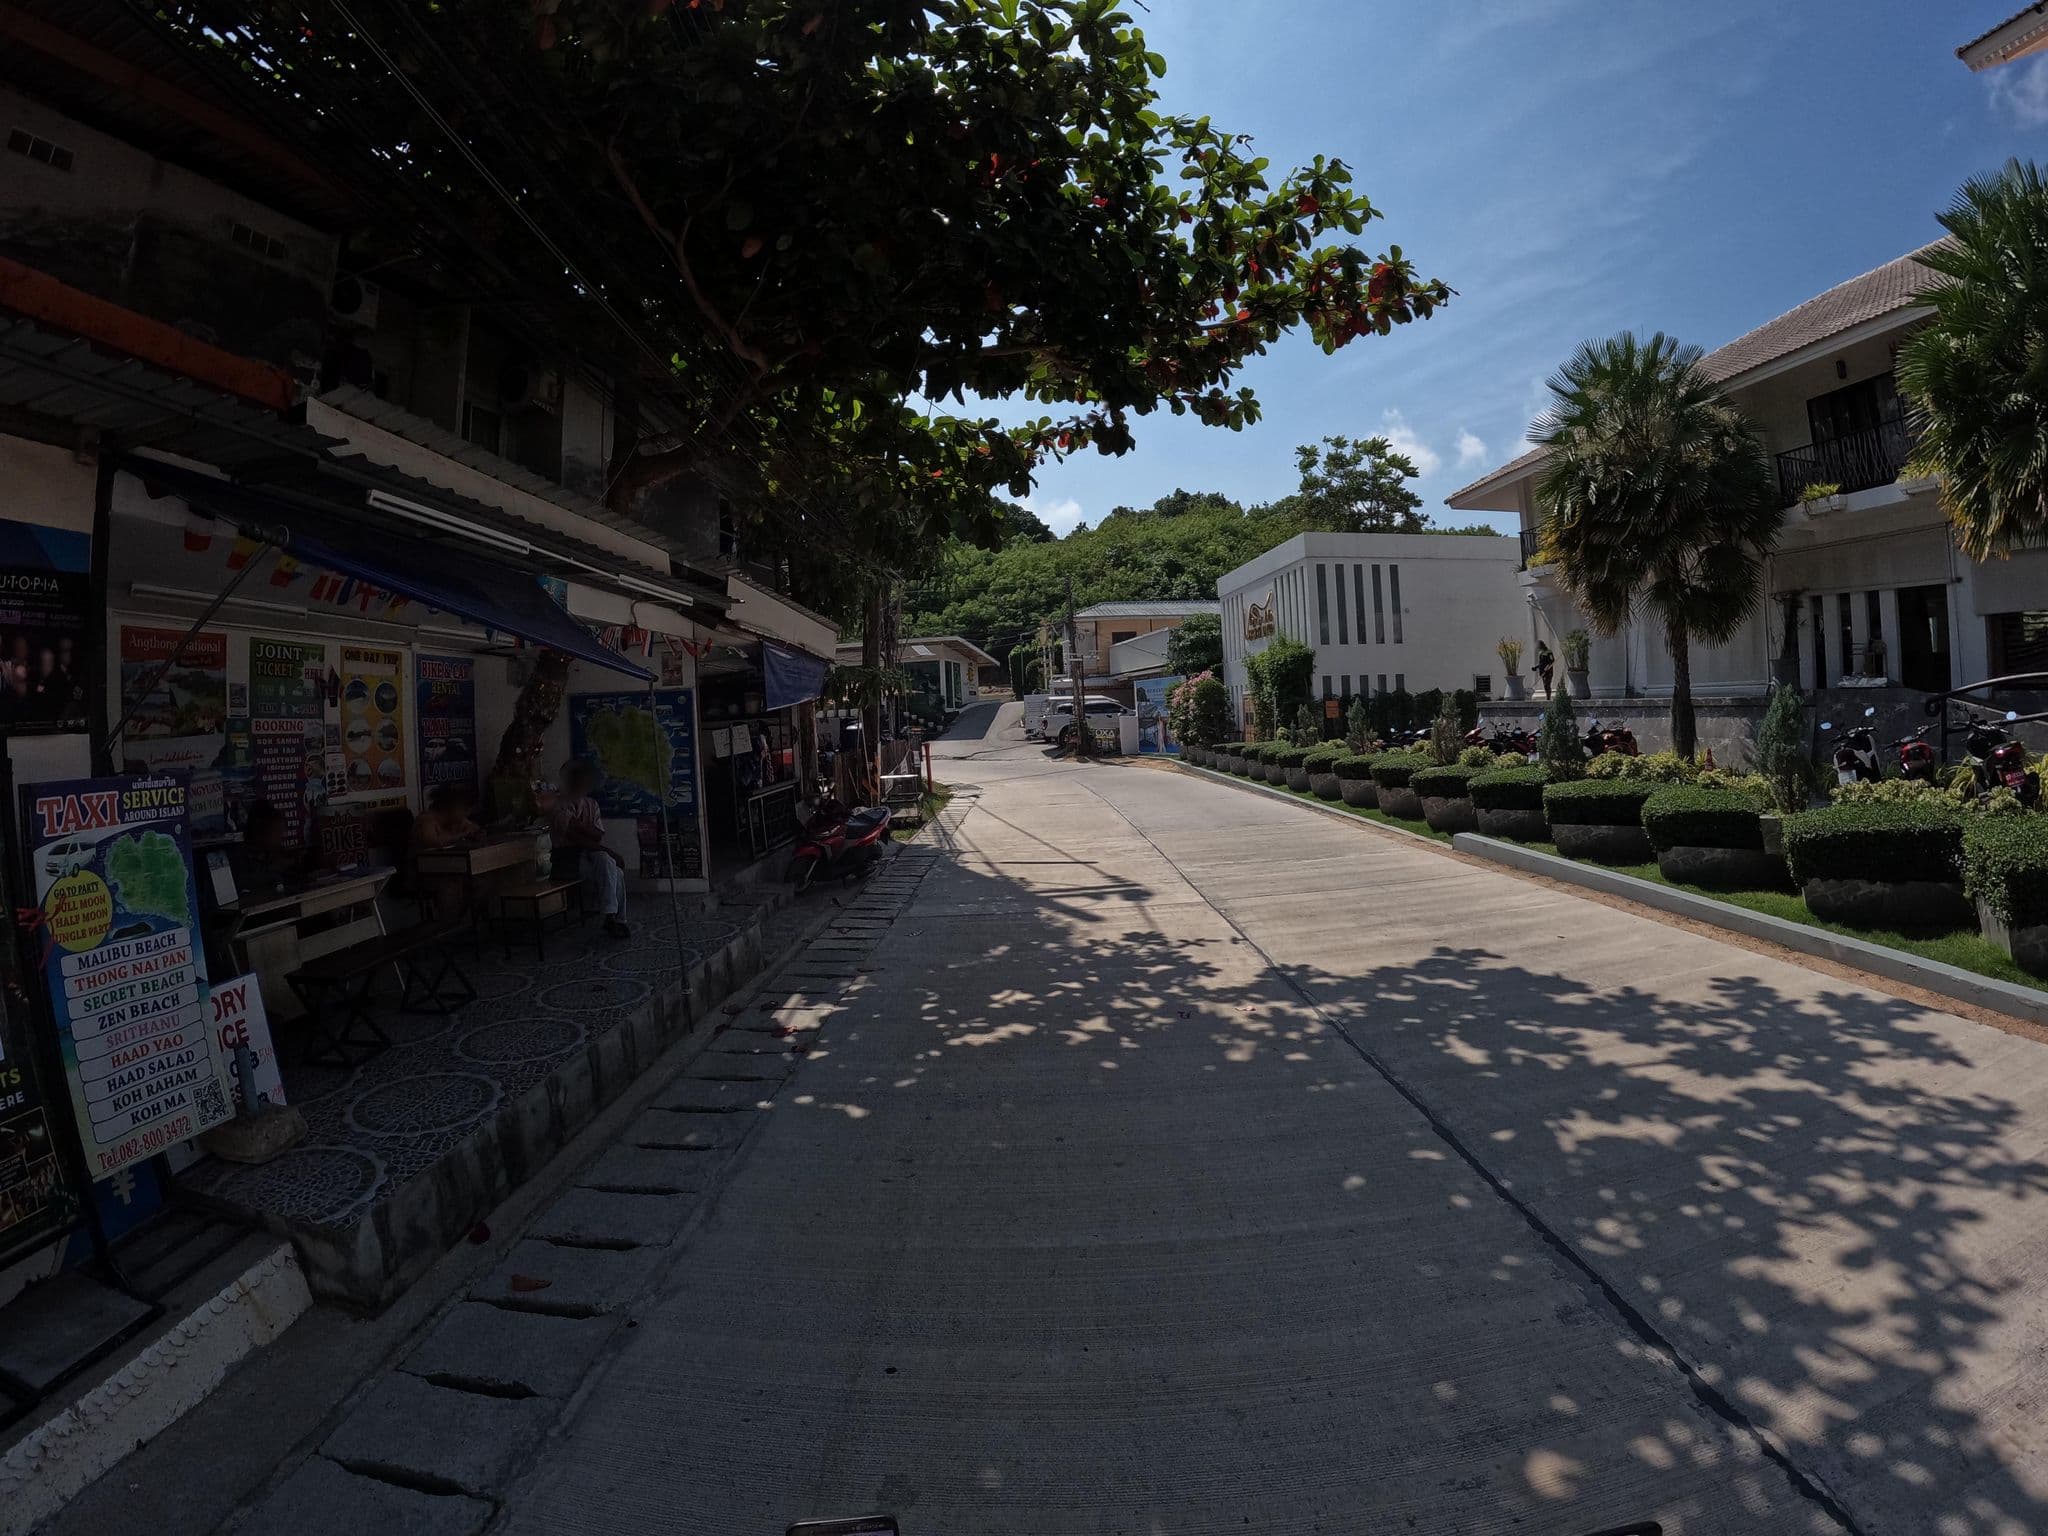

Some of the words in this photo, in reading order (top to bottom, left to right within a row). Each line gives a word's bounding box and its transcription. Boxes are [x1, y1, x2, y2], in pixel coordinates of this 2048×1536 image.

[180, 638, 222, 654] ational
[256, 644, 303, 661] JOINT
[256, 661, 294, 678] TICKET
[255, 720, 304, 732] BOOKING
[36, 790, 120, 838] TAXI
[122, 787, 185, 810] SERVICE
[124, 808, 157, 822] AROUND
[158, 805, 185, 819] ISLAND
[53, 887, 65, 898] GO
[66, 886, 77, 896] TO
[78, 881, 99, 895] PARTY
[79, 894, 106, 909] MOON
[55, 913, 81, 928] HALF
[82, 907, 108, 922] MOON
[78, 945, 131, 971] MALIBU
[135, 932, 177, 955] BEACH
[75, 965, 128, 992] THONG
[132, 956, 160, 977] NAI
[163, 950, 187, 969] PAN
[84, 984, 138, 1012] SECRET
[141, 970, 185, 995] BEACH
[98, 1009, 127, 1031] ZEN
[131, 993, 181, 1018] BEACH
[106, 1014, 181, 1048] SRITHANU
[111, 1043, 152, 1068] HAAD
[153, 1034, 184, 1053] YAO
[107, 1068, 146, 1093] HAAD
[148, 1050, 195, 1075] SALAD
[113, 1090, 143, 1112] KOH
[146, 1068, 198, 1096] RAHAM
[131, 1103, 161, 1125] KOH
[164, 1092, 187, 1113] MA
